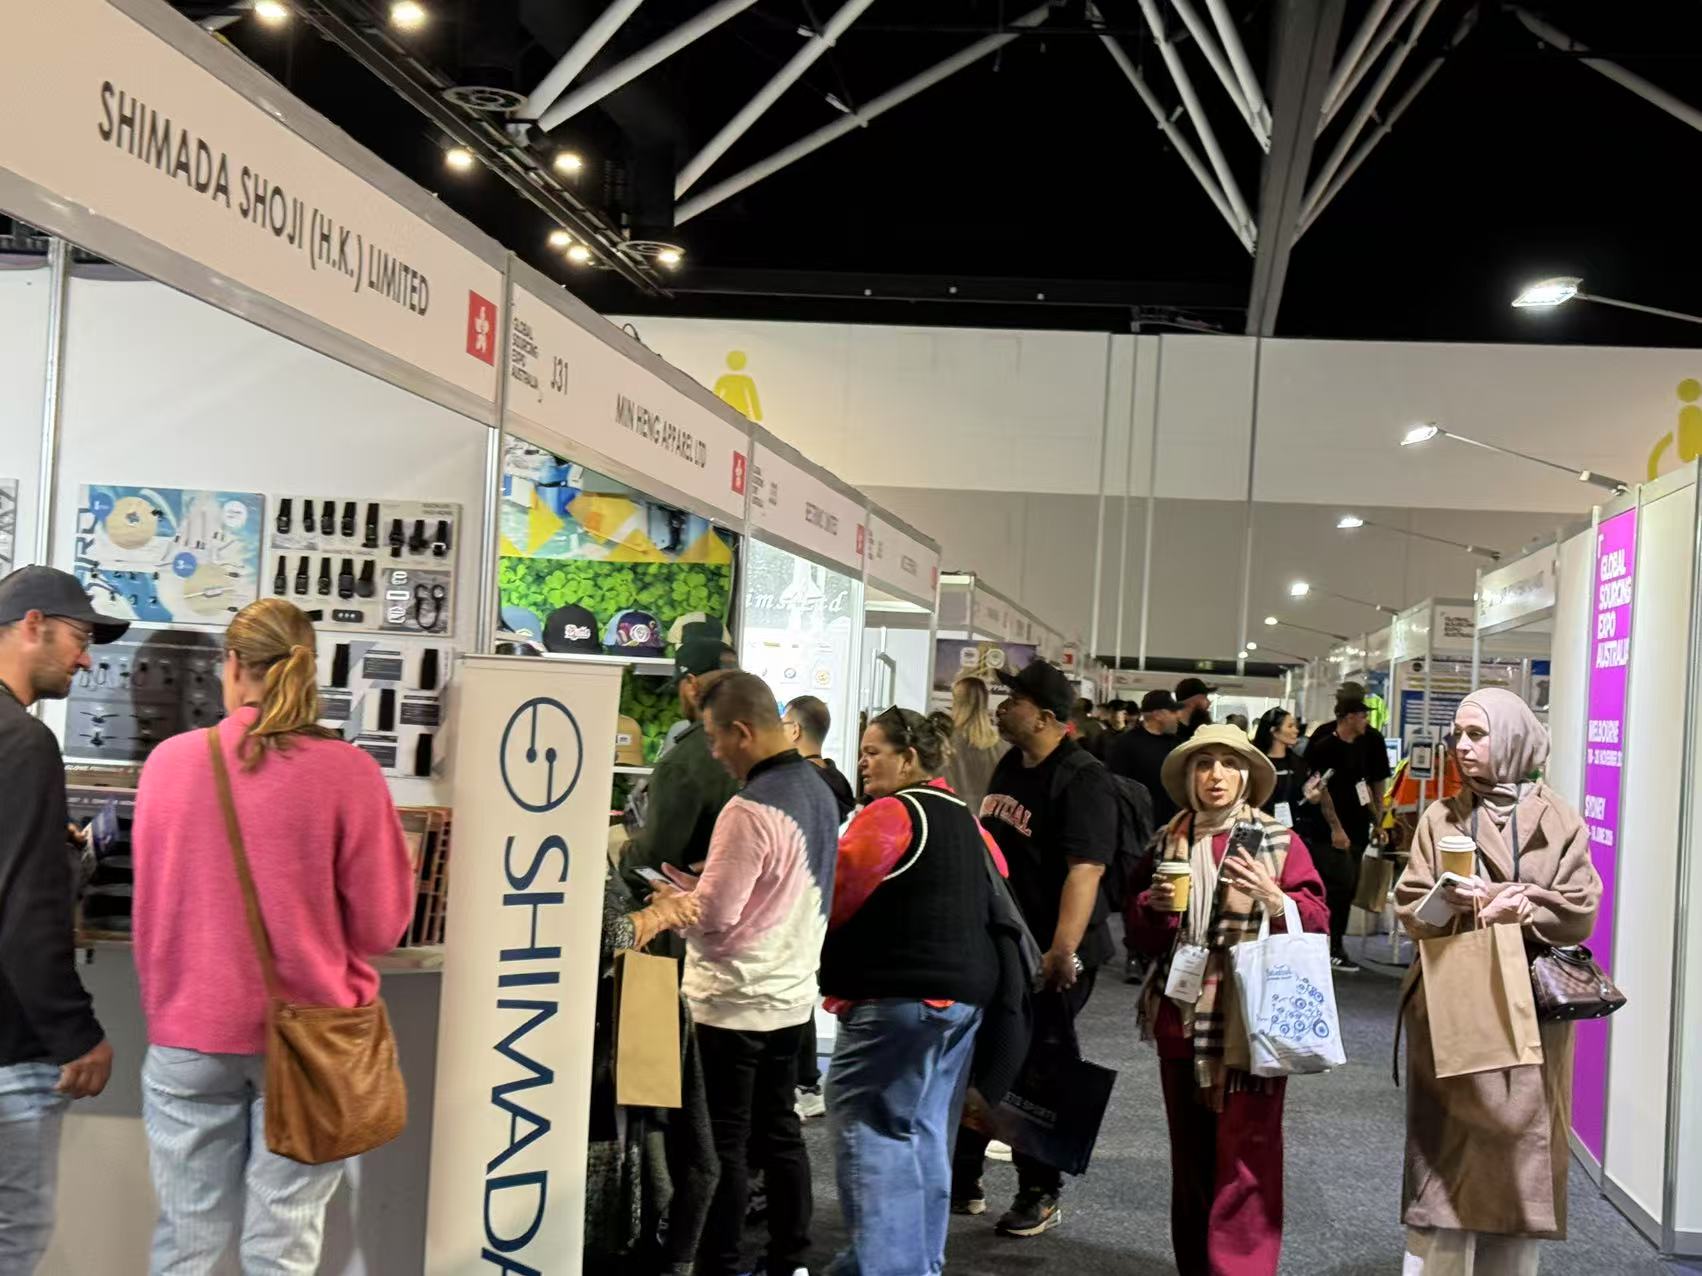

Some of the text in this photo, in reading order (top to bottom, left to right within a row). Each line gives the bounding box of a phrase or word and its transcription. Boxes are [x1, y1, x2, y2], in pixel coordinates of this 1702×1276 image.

[98, 80, 429, 316] SHIMADA SHOJI (H.K.) LIMITED
[551, 355, 568, 396] J31
[1600, 548, 1626, 582] GLOBAL
[1597, 610, 1617, 640] EXPO
